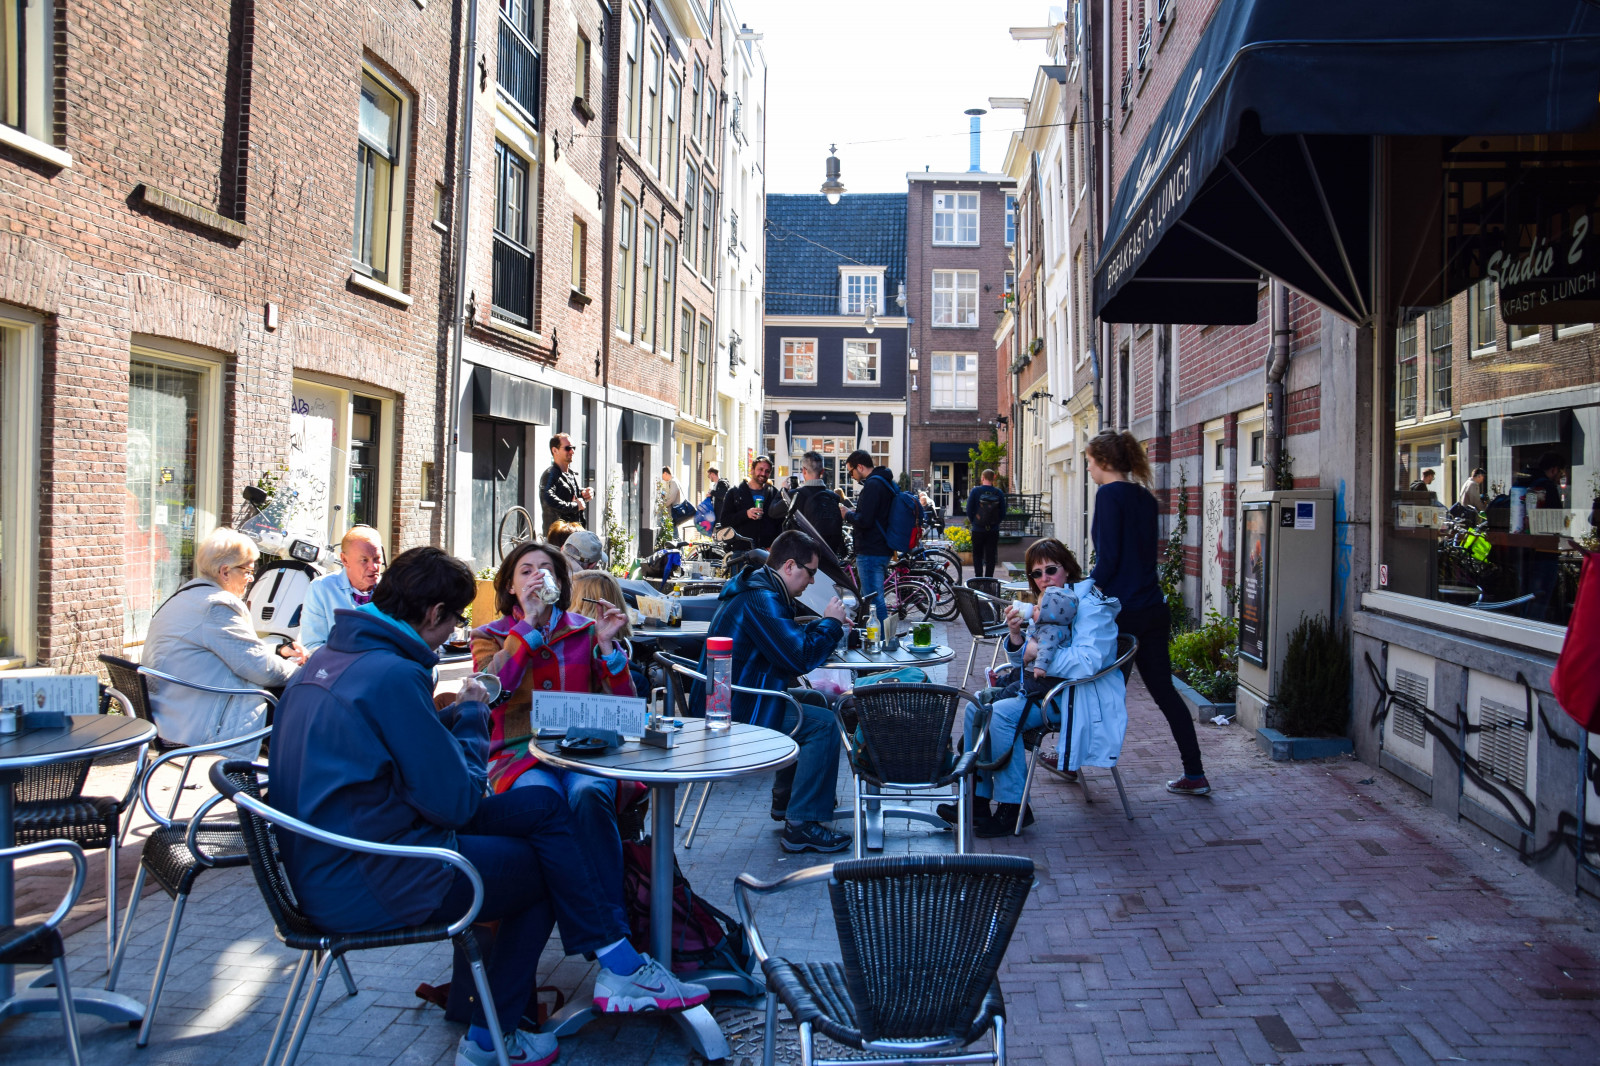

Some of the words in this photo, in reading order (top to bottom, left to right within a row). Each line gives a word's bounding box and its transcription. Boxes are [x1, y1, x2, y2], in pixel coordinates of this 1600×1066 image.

[1170, 67, 1202, 149] 2
[1107, 219, 1146, 290] BREAKFAST
[1148, 208, 1154, 239] &
[1157, 152, 1191, 228] LUNCH
[1487, 236, 1554, 290] Studio
[1567, 215, 1589, 264] 2
[1540, 288, 1548, 305] &
[1552, 271, 1596, 301] LUNCH
